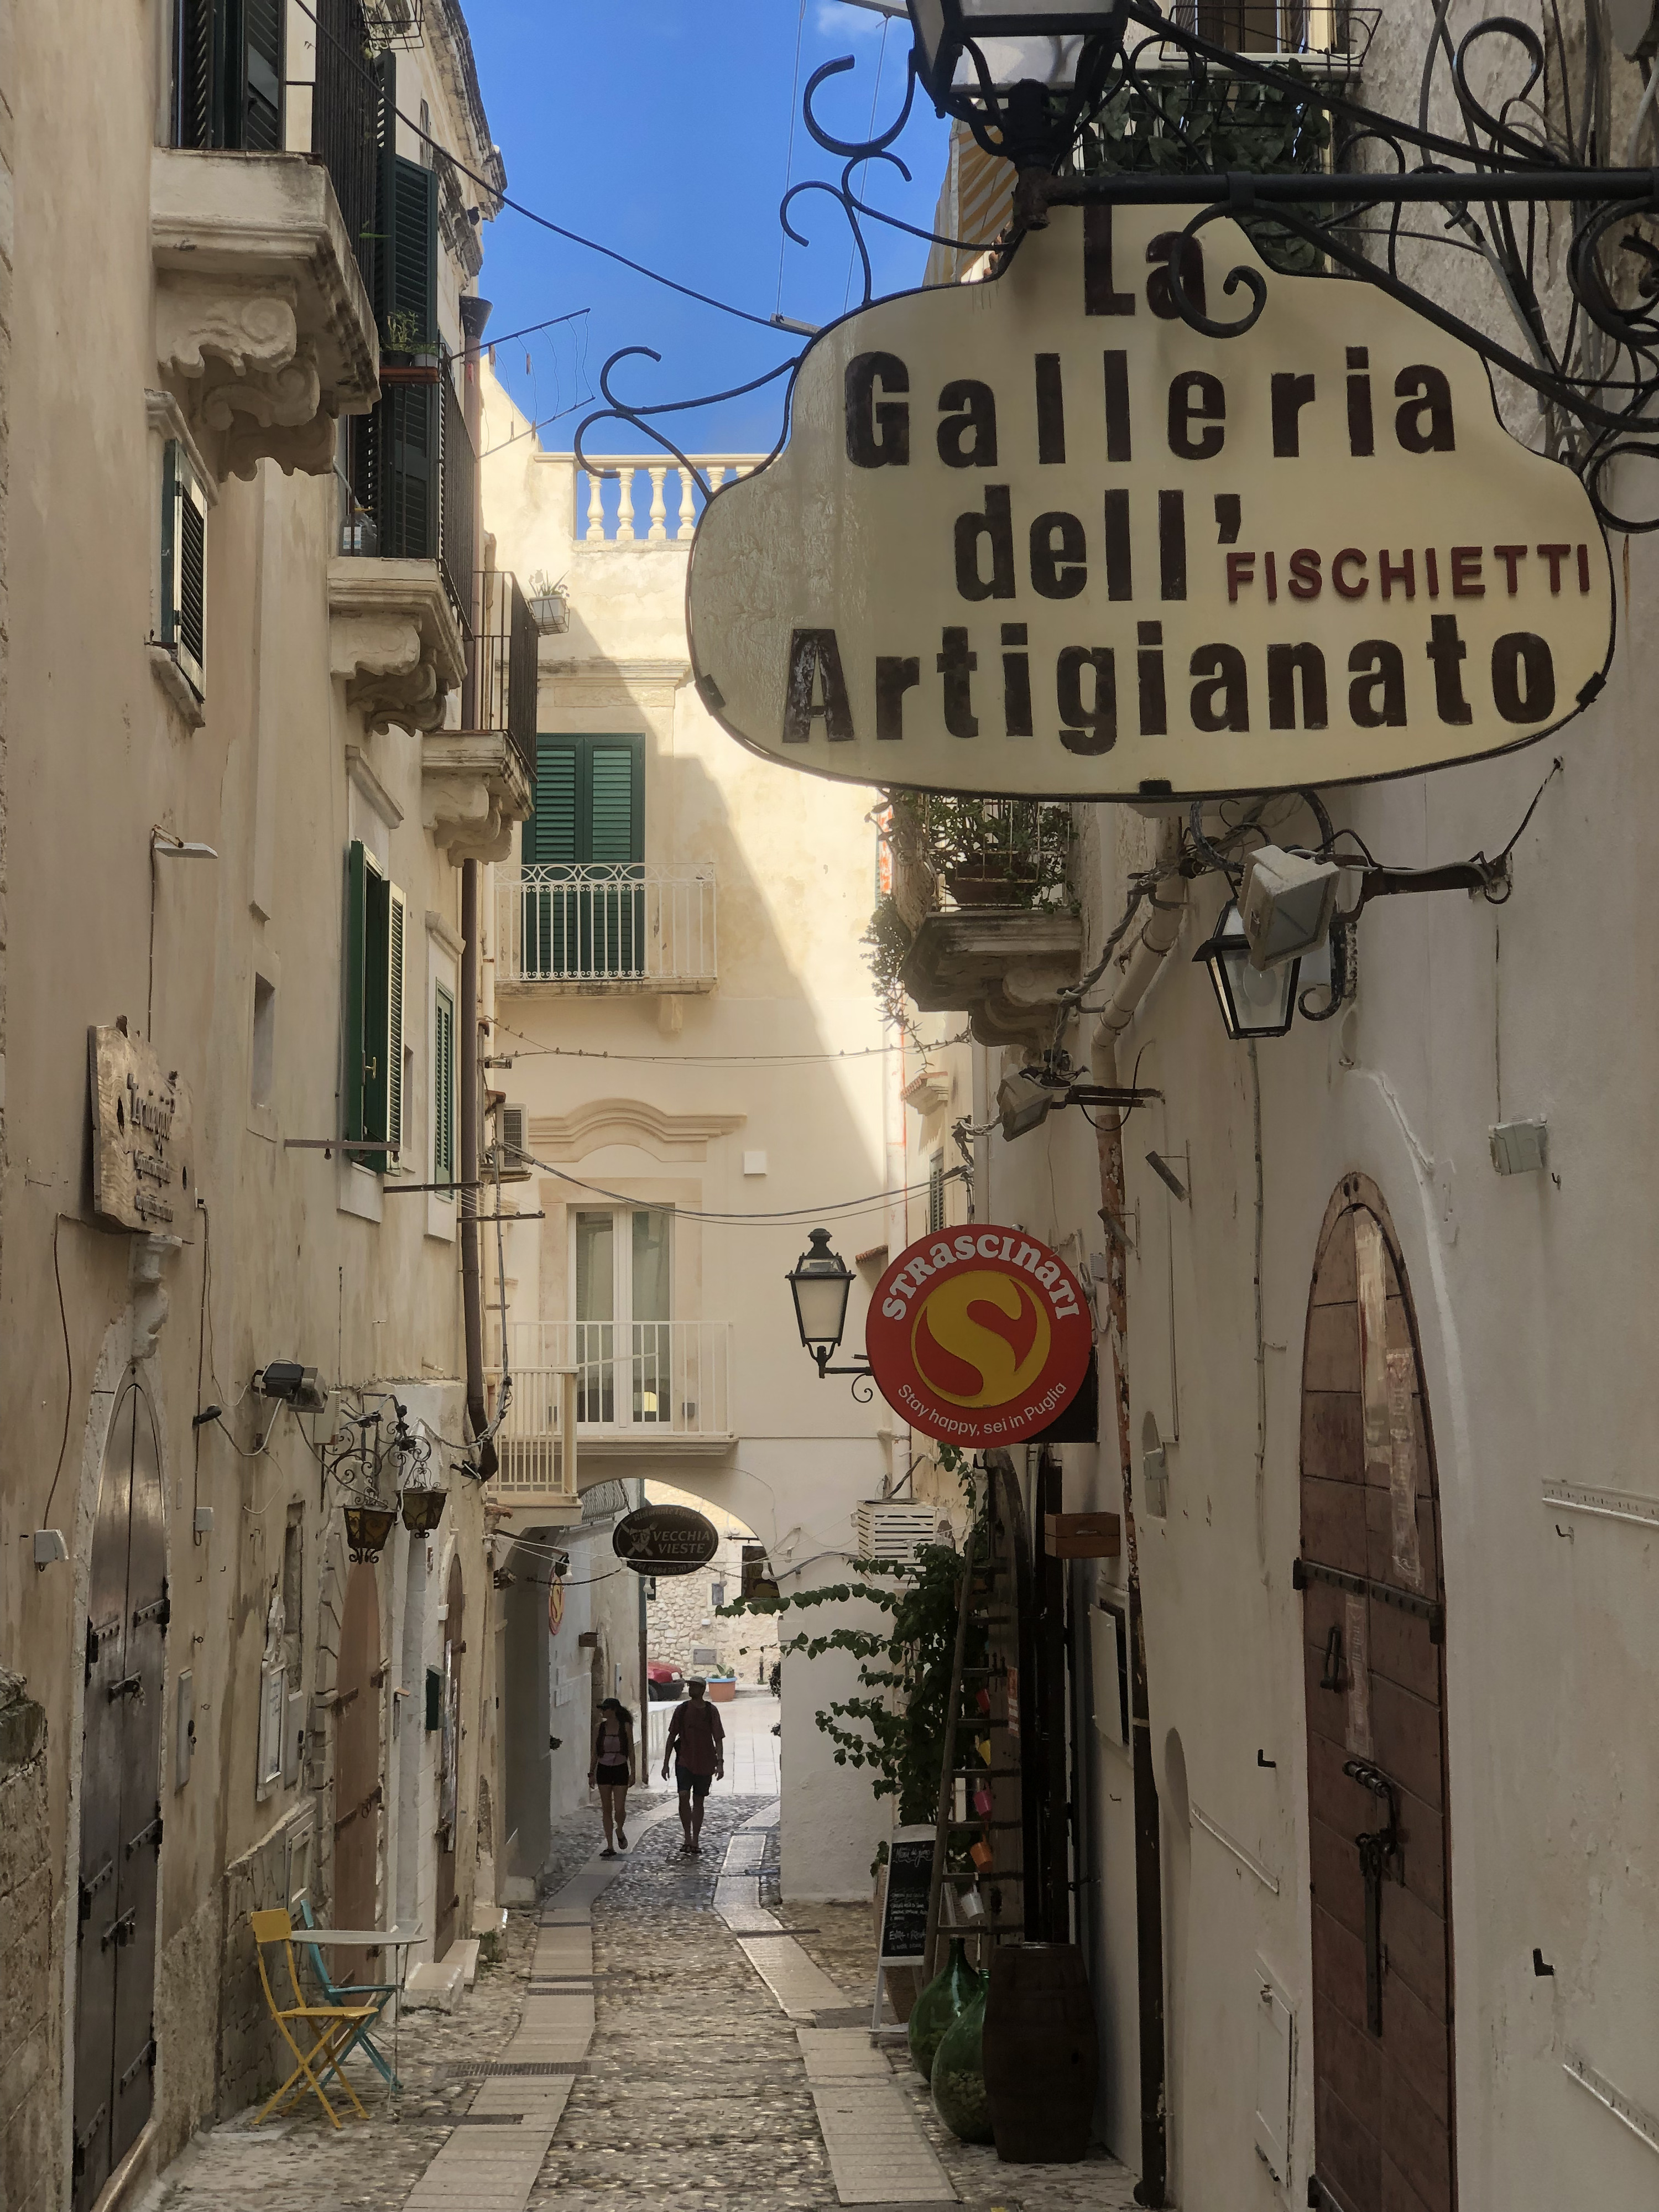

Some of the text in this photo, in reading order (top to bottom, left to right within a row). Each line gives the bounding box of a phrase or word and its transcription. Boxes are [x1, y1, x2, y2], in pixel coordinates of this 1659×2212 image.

[1084, 205, 1207, 320] La
[844, 346, 1455, 468] Galleria
[953, 484, 1244, 602] dell'
[1227, 543, 1591, 602] FISCHIETTI
[782, 614, 1556, 756] Artigianato
[898, 1383, 1067, 1437] Stay happy, sei in Puglia
[653, 1531, 710, 1542] VECCHIA
[658, 1543, 706, 1554] VIESTE
